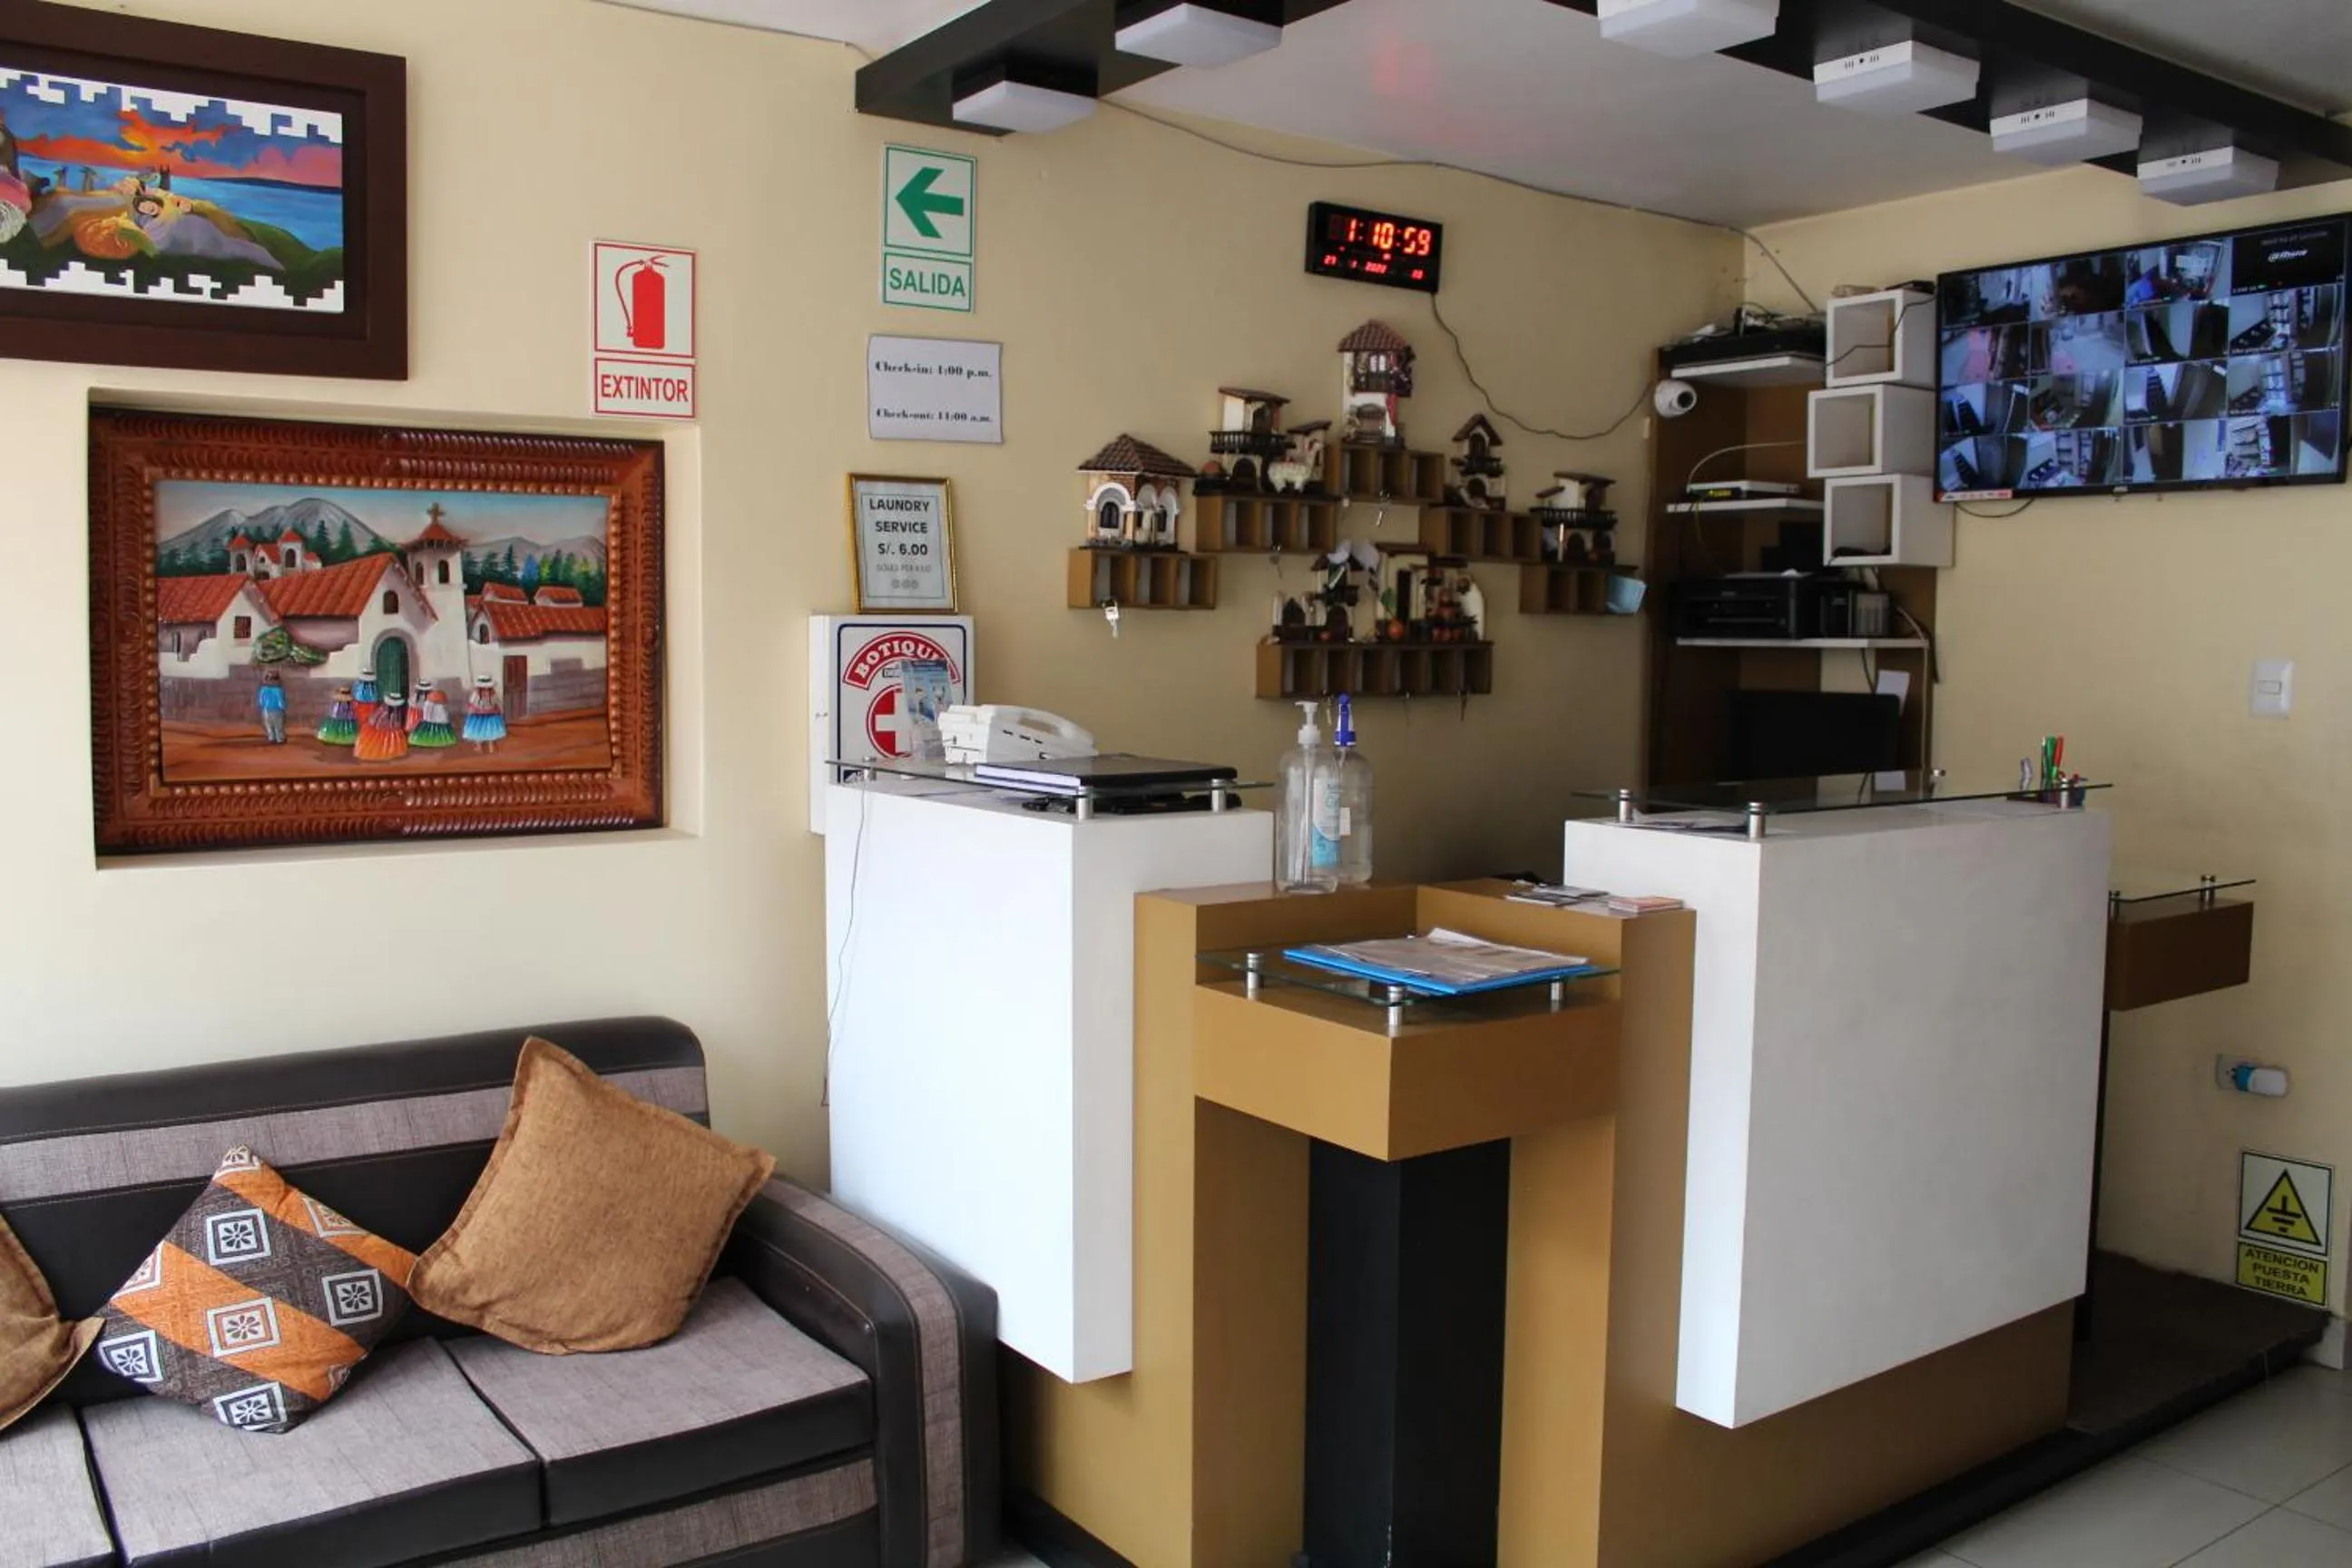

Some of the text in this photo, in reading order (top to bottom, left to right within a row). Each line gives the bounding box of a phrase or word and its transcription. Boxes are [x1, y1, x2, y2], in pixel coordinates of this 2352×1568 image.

[889, 267, 966, 298] SALIDA
[875, 360, 933, 375] Check-in:
[937, 364, 964, 376] 1:00
[601, 373, 689, 402] EXTINTOR
[937, 410, 967, 422] 11:00
[868, 497, 930, 513] LAUNDRY
[875, 520, 928, 534] SERVICE
[899, 543, 928, 556] 6.00
[2245, 1248, 2319, 1274] ATENCION
[2253, 1261, 2310, 1286] PUESTA
[2255, 1275, 2307, 1297] TIERRA
